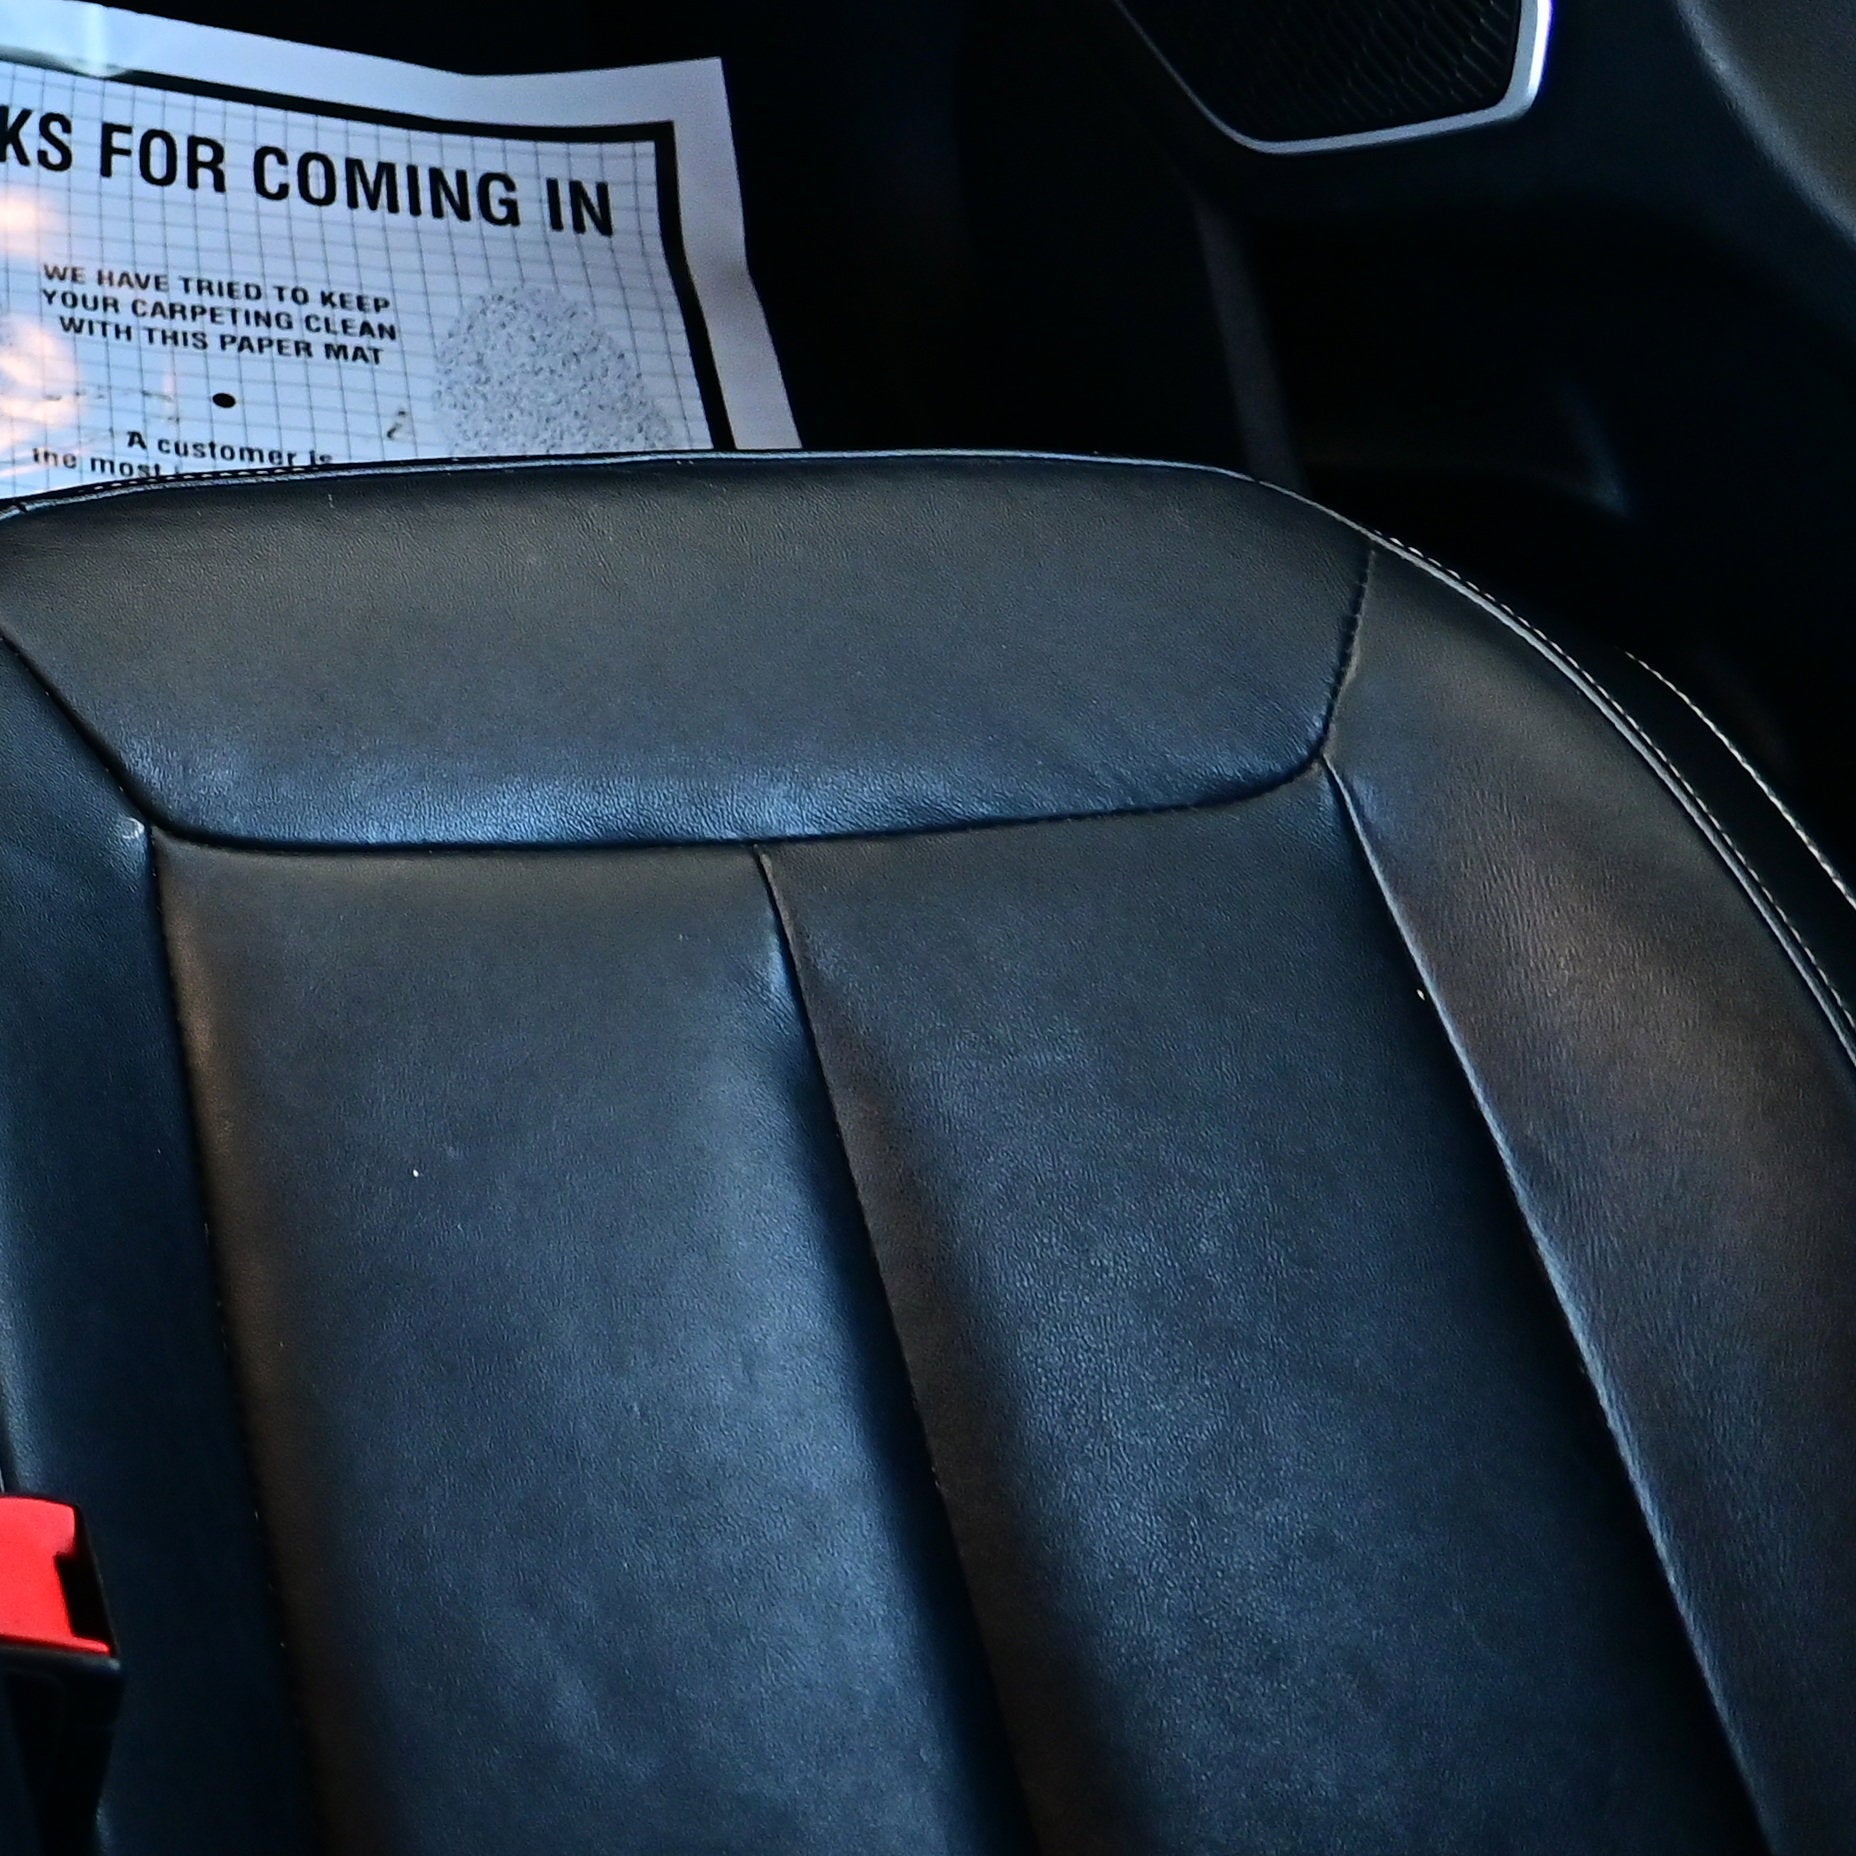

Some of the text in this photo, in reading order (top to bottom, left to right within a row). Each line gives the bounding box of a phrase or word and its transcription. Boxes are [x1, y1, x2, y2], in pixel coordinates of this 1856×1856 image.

[98, 122, 227, 193] FOR
[253, 145, 520, 228] COMING
[546, 177, 614, 237] IN
[44, 263, 390, 314] WE HAVE TRIED TO KEEP
[42, 288, 397, 341] YOUR CARPETING CLEAN
[59, 315, 384, 365] WITH THIS PAPER MAT
[32, 447, 77, 470] the
[90, 456, 163, 478] most
[126, 430, 148, 450] A
[157, 438, 297, 466] customer
